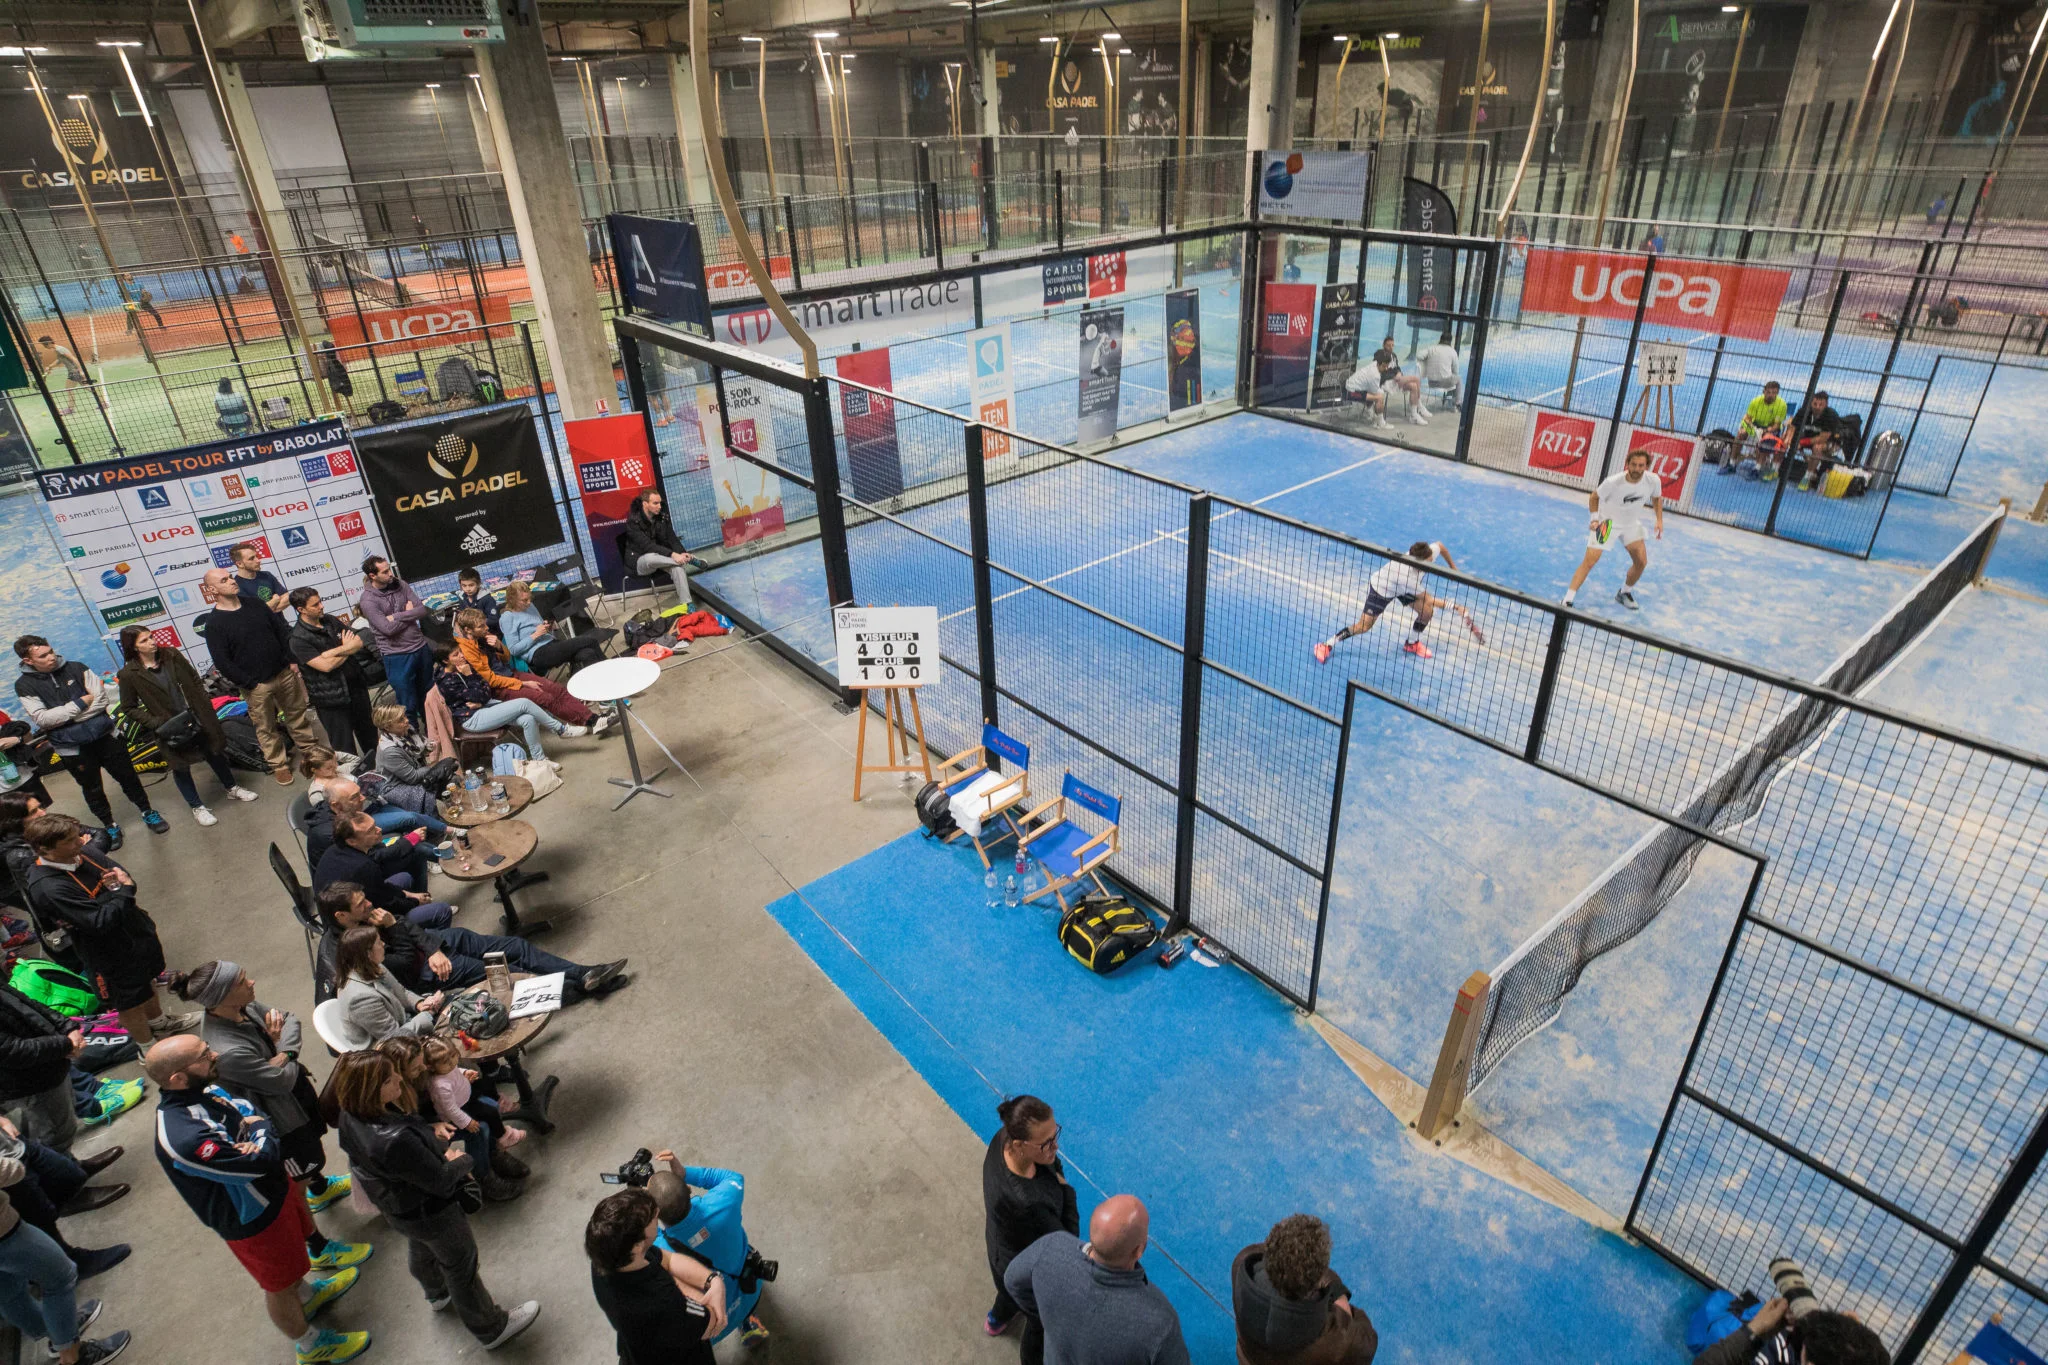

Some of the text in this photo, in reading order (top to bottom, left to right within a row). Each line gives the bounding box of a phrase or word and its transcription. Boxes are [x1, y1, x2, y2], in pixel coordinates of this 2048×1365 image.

[1070, 96, 1098, 108] PADEL
[91, 167, 164, 184] PADEL
[1046, 263, 1082, 277] CARLO
[1047, 283, 1084, 296] SPORTS
[730, 387, 752, 400] SON
[984, 408, 1004, 424] TEN
[986, 434, 1005, 452] NIS
[1538, 430, 1586, 458] RTL2
[68, 427, 343, 490] MY PADEL TOUR FFT by BABOLAT
[302, 458, 326, 467] MONTE
[582, 464, 611, 473] MONTE
[584, 470, 612, 479] CARLO
[224, 478, 238, 486] TEN
[586, 480, 614, 489] SPORTS
[228, 488, 242, 497] NIS
[329, 489, 364, 502] Babolat
[396, 470, 528, 512] CASA PADEL
[68, 504, 120, 520] smartTrade
[455, 508, 486, 522] powered by
[204, 512, 253, 528] HUTTOPIA
[338, 519, 362, 533] RTL2
[88, 542, 136, 556] BNP PARIBAS
[460, 534, 497, 551] adidas
[469, 544, 495, 556] PADEL
[170, 557, 210, 571] Babolat
[107, 602, 158, 619] HUTTOPIA
[860, 632, 914, 641] VISITEUR
[858, 643, 918, 656] 4 0 0
[874, 657, 904, 665] CLUB
[861, 666, 919, 680] 1 0 0
[84, 1036, 128, 1046] EAD
